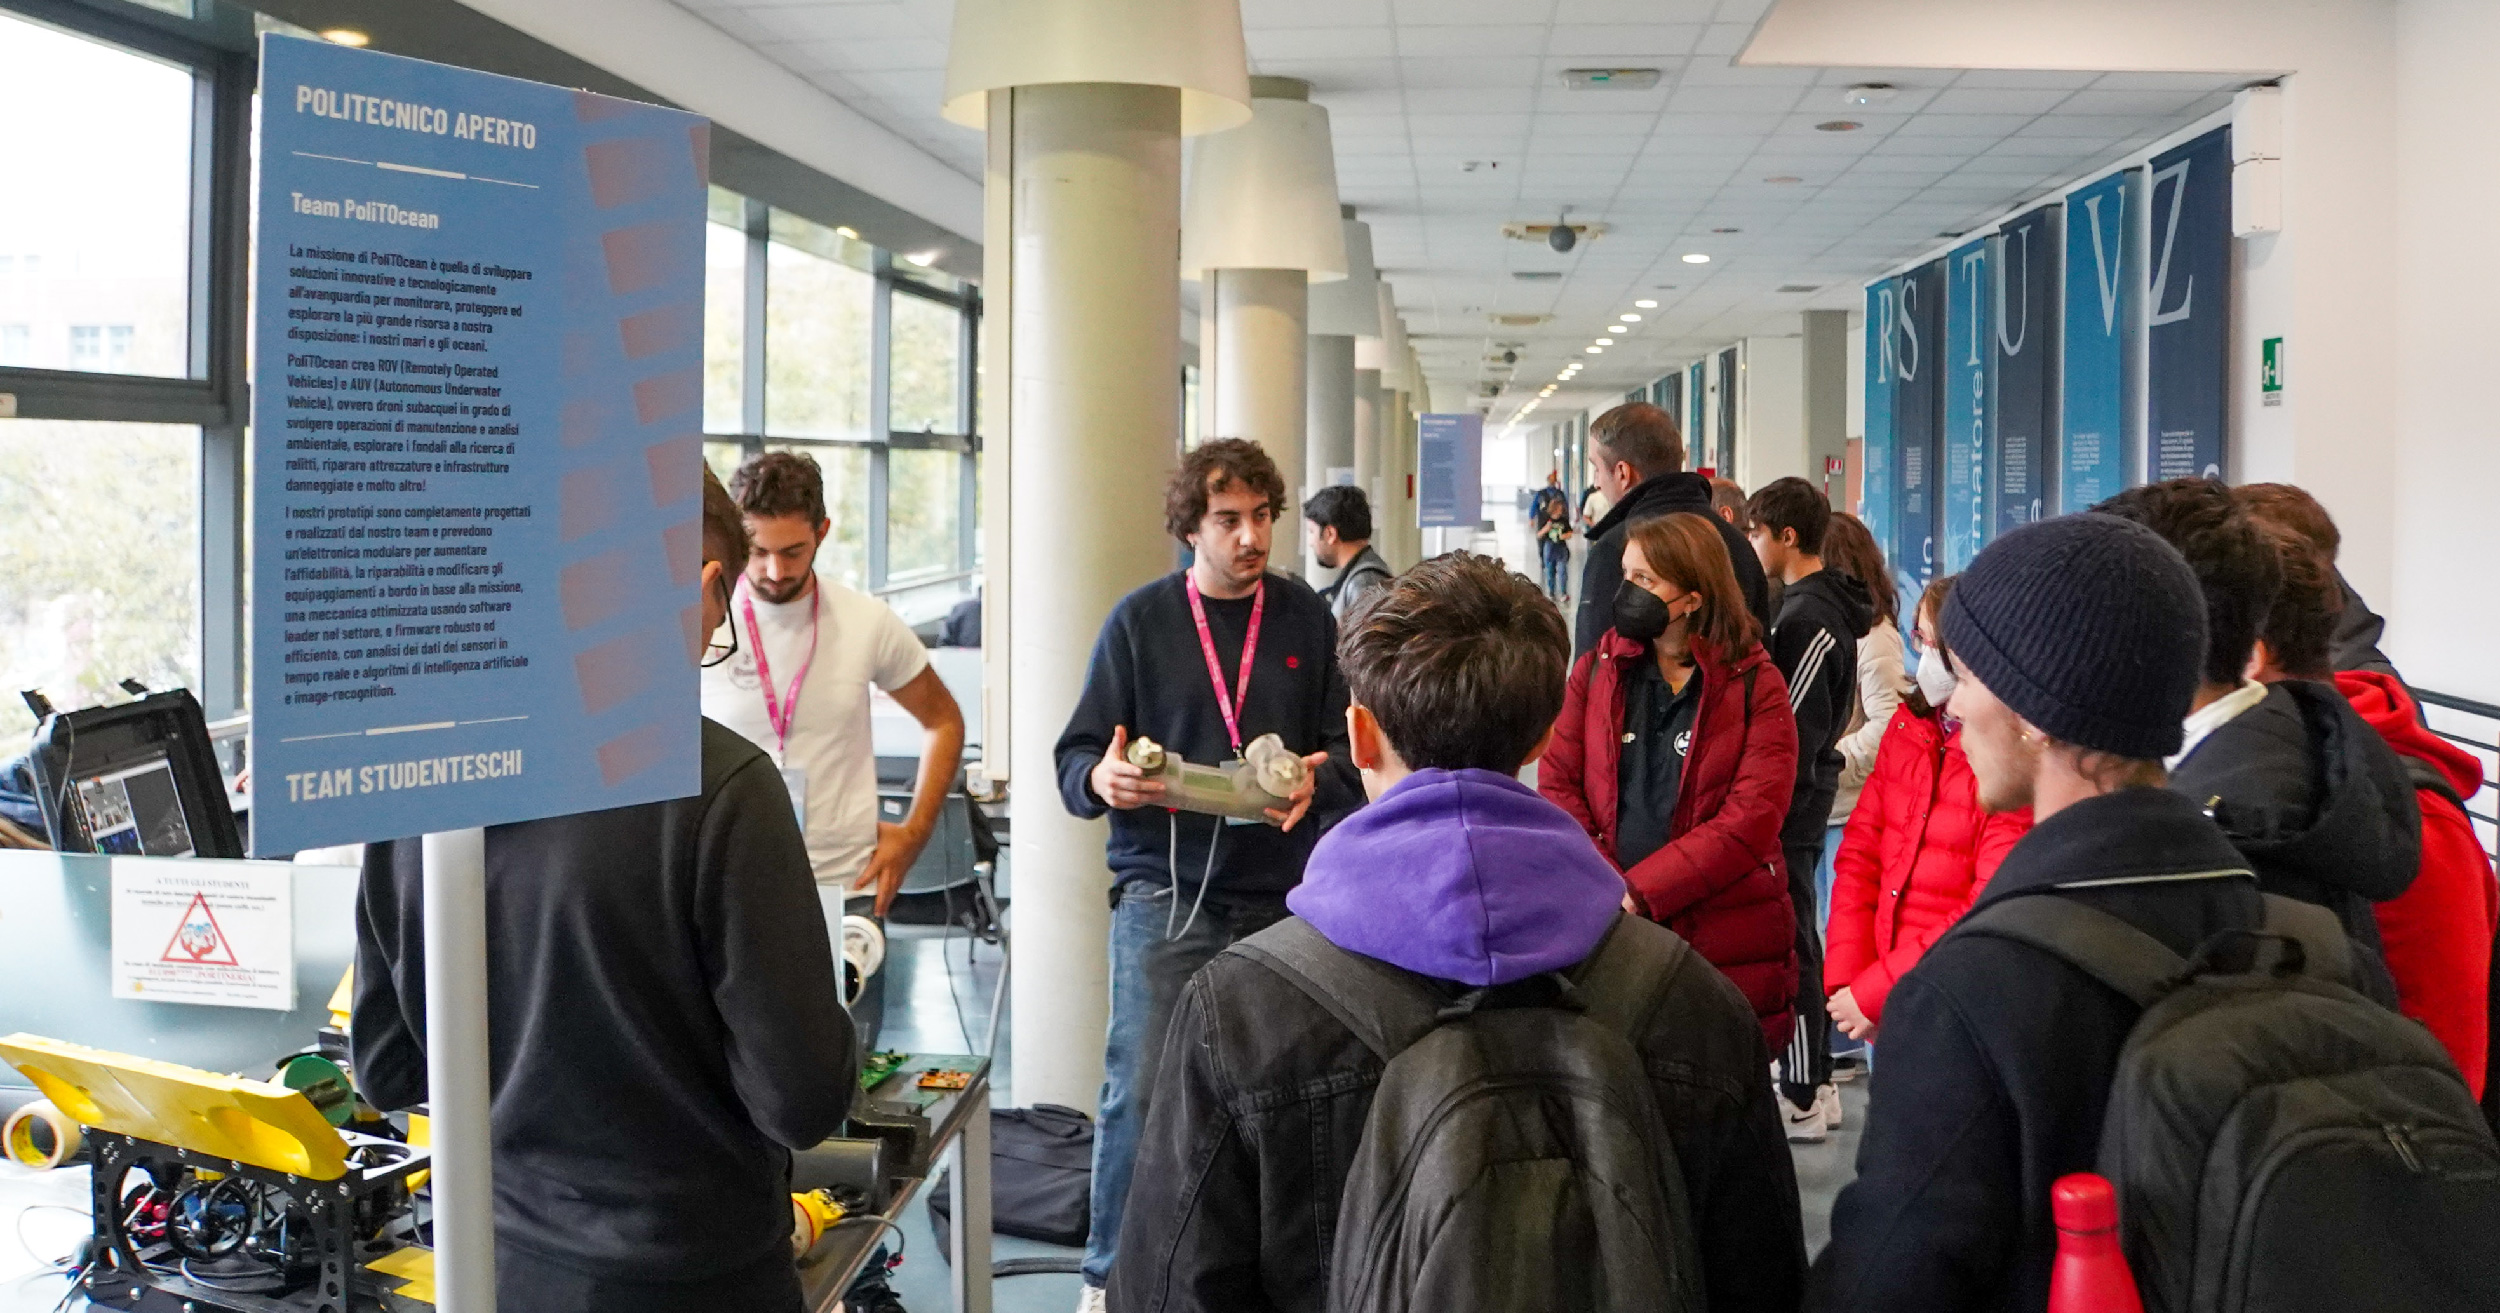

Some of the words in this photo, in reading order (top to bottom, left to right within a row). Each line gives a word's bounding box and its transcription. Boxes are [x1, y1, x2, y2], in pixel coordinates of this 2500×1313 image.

[296, 84, 447, 135] POLITECNICO
[454, 111, 535, 149] APERTO
[291, 192, 339, 217] Team
[344, 198, 438, 229] PoliTOcean
[2149, 159, 2193, 327] Z
[290, 244, 303, 258] La
[306, 246, 355, 263] missione
[358, 251, 368, 264] di
[371, 252, 428, 270] PoliTOcean
[439, 261, 469, 275] quella
[472, 262, 481, 275] di
[483, 265, 532, 281] sviluppare
[2084, 185, 2125, 337] V
[289, 265, 338, 281] soluzioni
[342, 269, 396, 286] innovative
[408, 276, 496, 295] tecnologicamente
[1997, 225, 2031, 356] U
[289, 285, 370, 304] all'avanguardia
[373, 295, 390, 308] per
[394, 295, 452, 313] monitorare,
[455, 301, 508, 317] proteggere
[511, 305, 522, 316] ed
[1962, 249, 1985, 367] T
[289, 307, 341, 322] esplorare
[344, 310, 354, 323] la
[356, 311, 373, 326] più
[376, 314, 412, 328] grande
[415, 315, 450, 330] risorsa
[461, 321, 493, 333] nostra
[1900, 278, 1919, 382] S
[288, 326, 360, 343] disposizione:
[369, 333, 400, 346] nostri
[403, 335, 426, 347] mari
[438, 337, 450, 352] gli
[453, 339, 487, 351] oceani.
[1878, 288, 1893, 384] R
[288, 354, 348, 369] PoliTOcean
[351, 360, 375, 371] crea
[378, 359, 398, 372] ROV
[401, 360, 451, 378] (Remotely
[454, 364, 498, 379] Operated
[287, 374, 337, 391] Vehicles)
[350, 377, 370, 390] AUV
[374, 378, 442, 394] (Autonomous
[445, 382, 502, 397] Underwater
[287, 395, 334, 411] Vehicle),
[337, 400, 373, 411] ovvero
[376, 399, 404, 412] droni
[406, 401, 458, 416] subacquei
[460, 402, 469, 414] in
[472, 404, 499, 418] grado
[502, 404, 511, 416] di
[286, 416, 333, 432] svolgere
[337, 418, 392, 433] operazioni
[395, 419, 404, 432] di
[407, 421, 477, 434] manutenzione
[488, 423, 519, 435] analisi
[286, 436, 351, 452] ambientale,
[354, 438, 403, 453] esplorare
[412, 439, 447, 452] fondali
[449, 441, 467, 453] alla
[469, 441, 503, 454] ricerca
[506, 442, 515, 454] di
[286, 457, 319, 472] relitti,
[323, 458, 366, 473] riparare
[369, 459, 432, 472] attrezzature
[443, 460, 509, 473] infrastrutture
[1970, 371, 1983, 556] rmatore
[286, 478, 354, 494] danneggiate
[366, 479, 396, 491] molto
[399, 479, 427, 491] altro!
[292, 505, 325, 517] nostri
[328, 505, 374, 521] prototipi
[376, 508, 402, 517] sono
[404, 505, 481, 520] completamente
[484, 505, 531, 520] progettati
[295, 525, 346, 538] realizzati
[349, 525, 365, 537] dal
[368, 526, 401, 537] nostro
[404, 526, 430, 537] team
[441, 525, 493, 540] prevedono
[285, 545, 360, 559] un'elettronica
[363, 545, 411, 557] modulare
[414, 547, 431, 560] per
[434, 545, 487, 556] aumentare
[285, 566, 353, 581] l'affidabilità,
[356, 566, 365, 578] la
[368, 564, 425, 581] riparabilità
[436, 563, 489, 576] modificare
[491, 563, 503, 578] gli
[285, 585, 376, 603] equipaggiamenti
[388, 584, 417, 597] bordo
[420, 584, 430, 596] in
[433, 584, 456, 596] base
[459, 583, 476, 595] alla
[479, 581, 523, 595] missione,
[285, 611, 306, 621] una
[309, 606, 367, 620] meccanica
[371, 604, 428, 618] ottimizzata
[430, 602, 466, 615] usando
[469, 601, 512, 614] software
[285, 629, 319, 642] leader
[323, 627, 339, 640] nel
[342, 627, 383, 640] settore,
[395, 624, 440, 637] firmware
[443, 622, 481, 634] robusto
[484, 620, 495, 632] ed
[285, 648, 340, 663] efficiente,
[344, 649, 363, 659] con
[366, 644, 401, 658] analisi
[403, 643, 419, 656] dei
[421, 642, 441, 655] dati
[443, 641, 458, 653] dei
[461, 639, 496, 652] sensori
[499, 638, 508, 650] in
[285, 671, 319, 685] tempo
[323, 667, 350, 681] reale
[363, 663, 409, 680] algoritmi
[412, 662, 421, 675] di
[424, 660, 480, 675] intelligenza
[483, 656, 529, 670] artificiale
[295, 685, 396, 705] image-recognition.
[286, 768, 352, 802] TEAM
[359, 749, 521, 793] STUDENTESCHI
